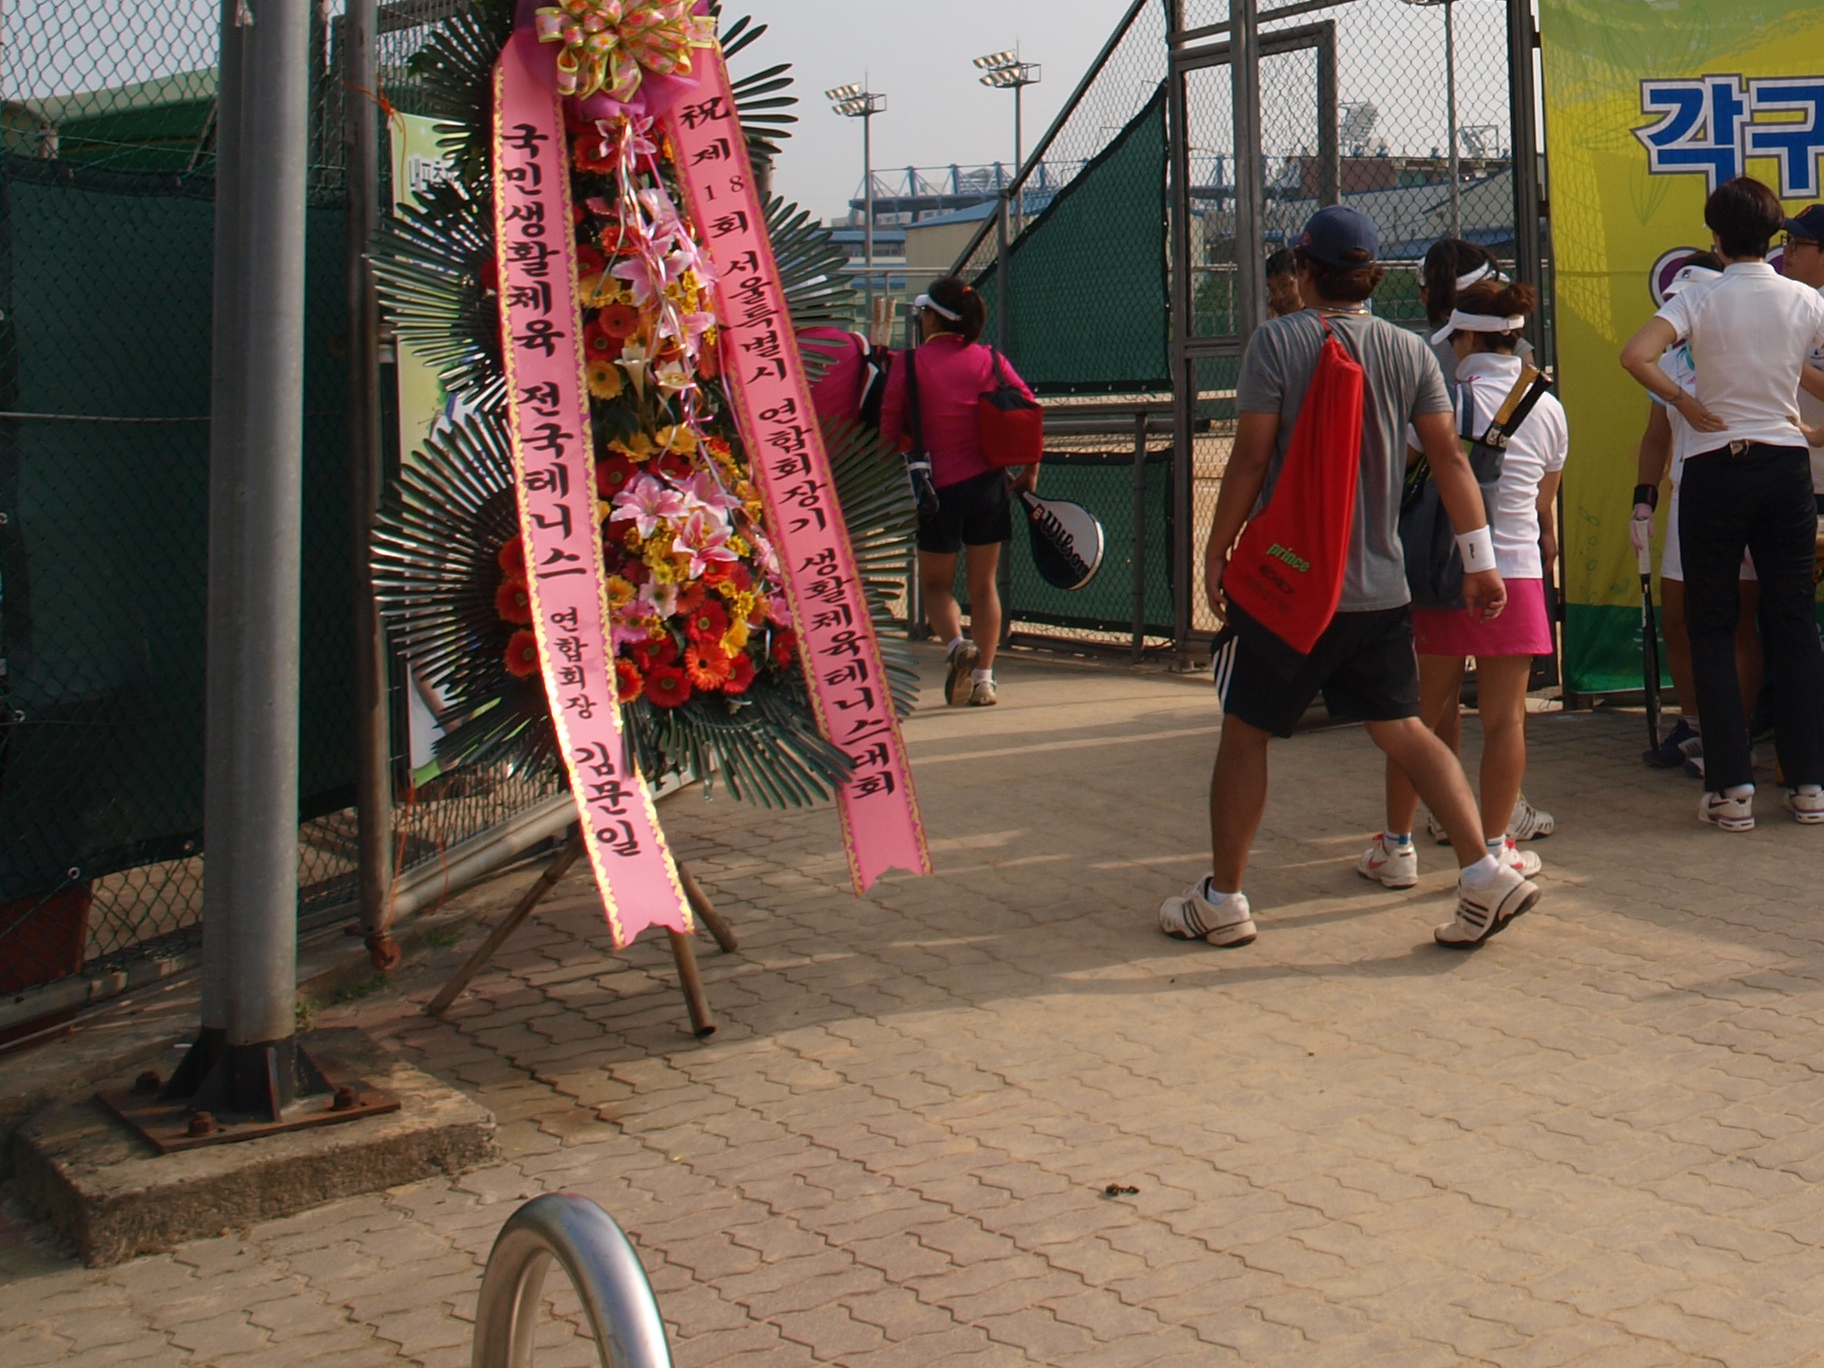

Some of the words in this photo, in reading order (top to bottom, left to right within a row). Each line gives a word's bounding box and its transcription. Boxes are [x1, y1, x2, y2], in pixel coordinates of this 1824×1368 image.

[500, 122, 566, 358] 국민생활체육
[722, 249, 789, 384] 서울특별시
[517, 382, 588, 580] 전국테니스
[1266, 543, 1310, 572] prince
[549, 606, 598, 720] 연합회장
[573, 742, 643, 858] 김문일
